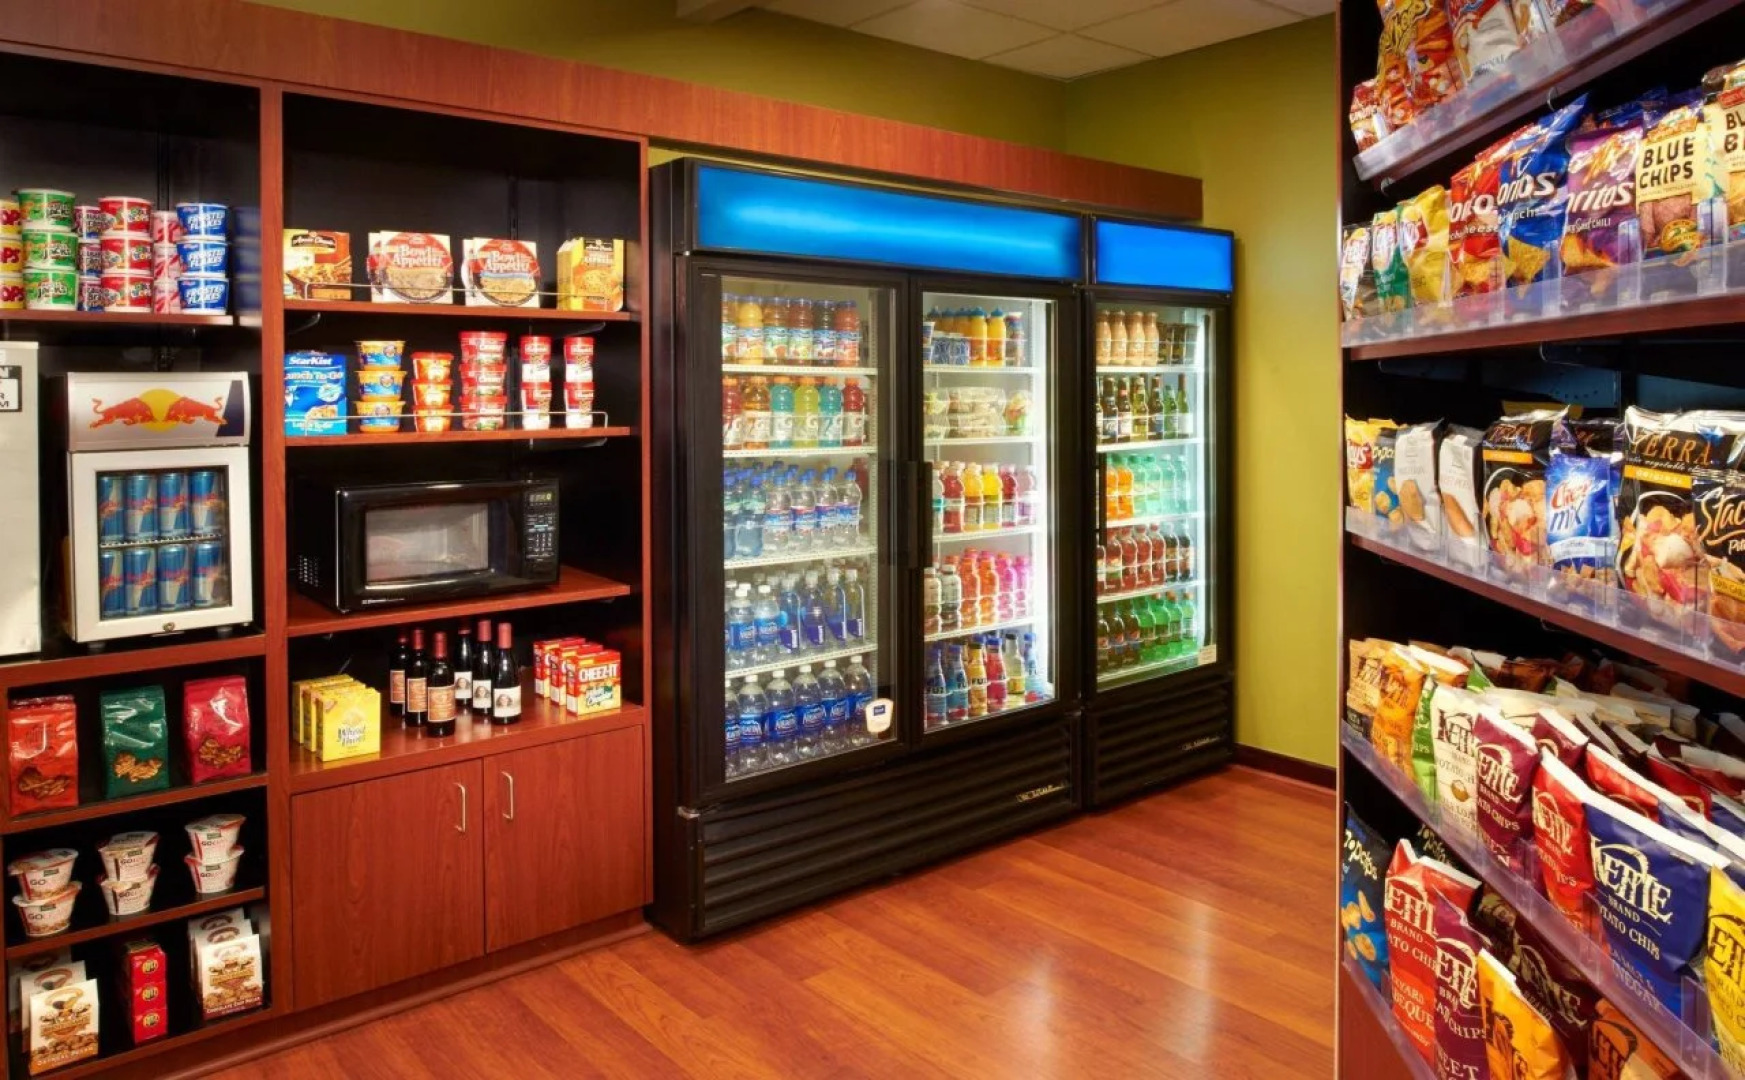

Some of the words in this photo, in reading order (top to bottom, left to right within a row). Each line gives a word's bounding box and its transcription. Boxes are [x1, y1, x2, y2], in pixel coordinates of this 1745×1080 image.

[1643, 137, 1695, 170] BLUE
[1639, 160, 1695, 189] CHIPS
[289, 356, 333, 366] StarKist
[579, 663, 619, 684] CHEEZ-IT
[1590, 835, 1674, 925] KETTLE
[1608, 894, 1641, 923] BRAND
[1390, 917, 1423, 945] BRAND
[1628, 929, 1660, 961] CHIPS
